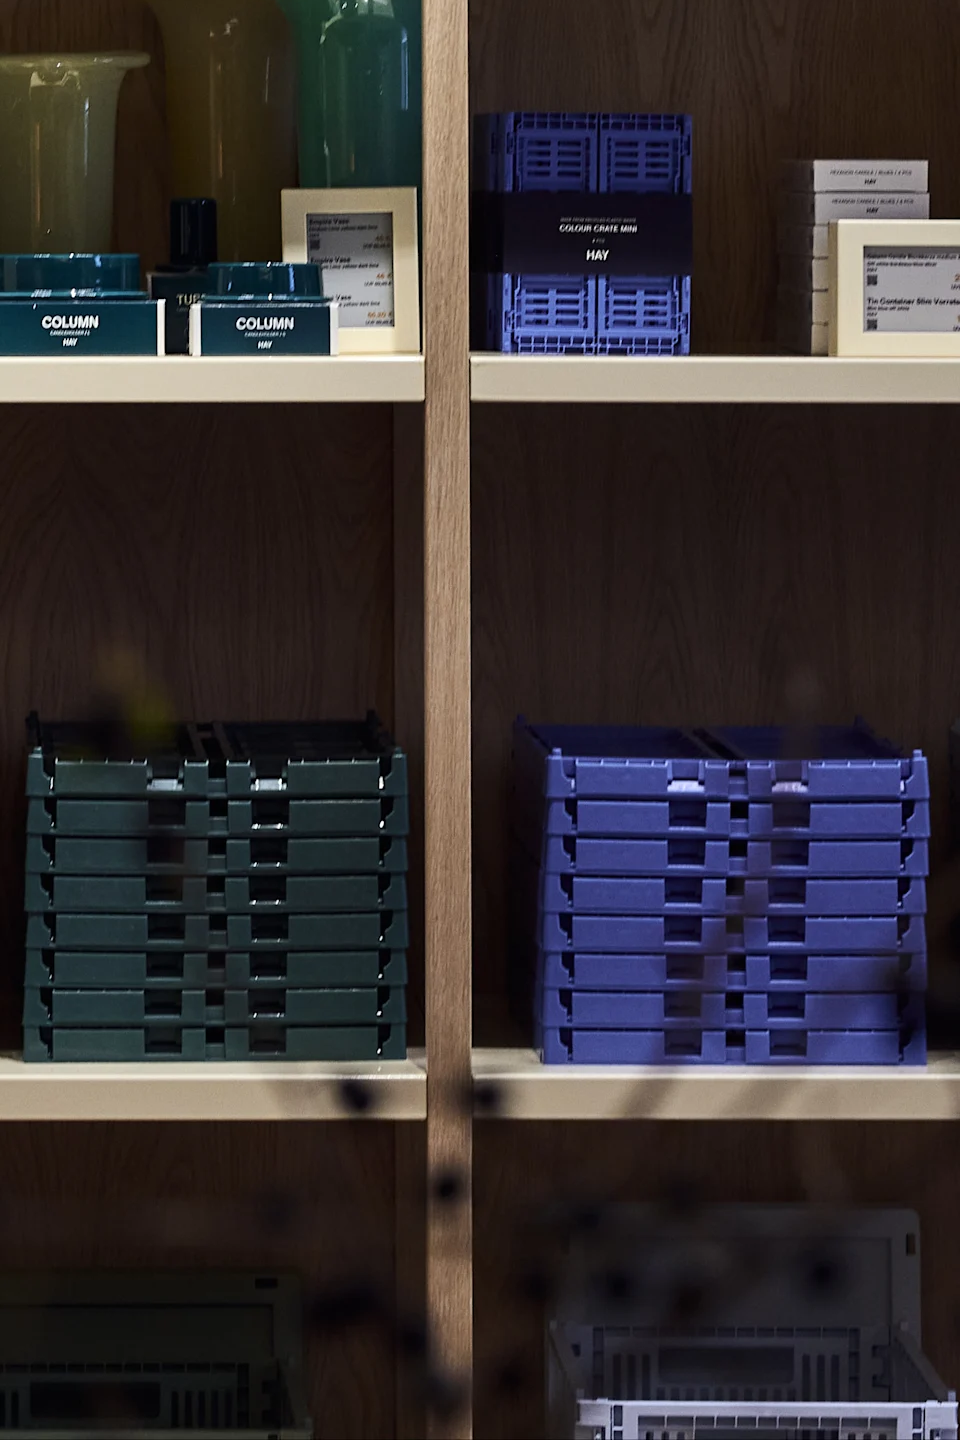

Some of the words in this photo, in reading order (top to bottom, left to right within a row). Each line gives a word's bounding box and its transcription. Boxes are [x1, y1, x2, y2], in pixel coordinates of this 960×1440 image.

[559, 224, 592, 233] COLOUR
[594, 224, 618, 233] CRATE
[620, 224, 638, 233] MINI
[586, 249, 610, 261] HAY
[42, 315, 99, 329] COLUMN
[236, 316, 294, 330] COLUMN
[62, 338, 78, 347] HAY
[258, 340, 273, 350] HAY
